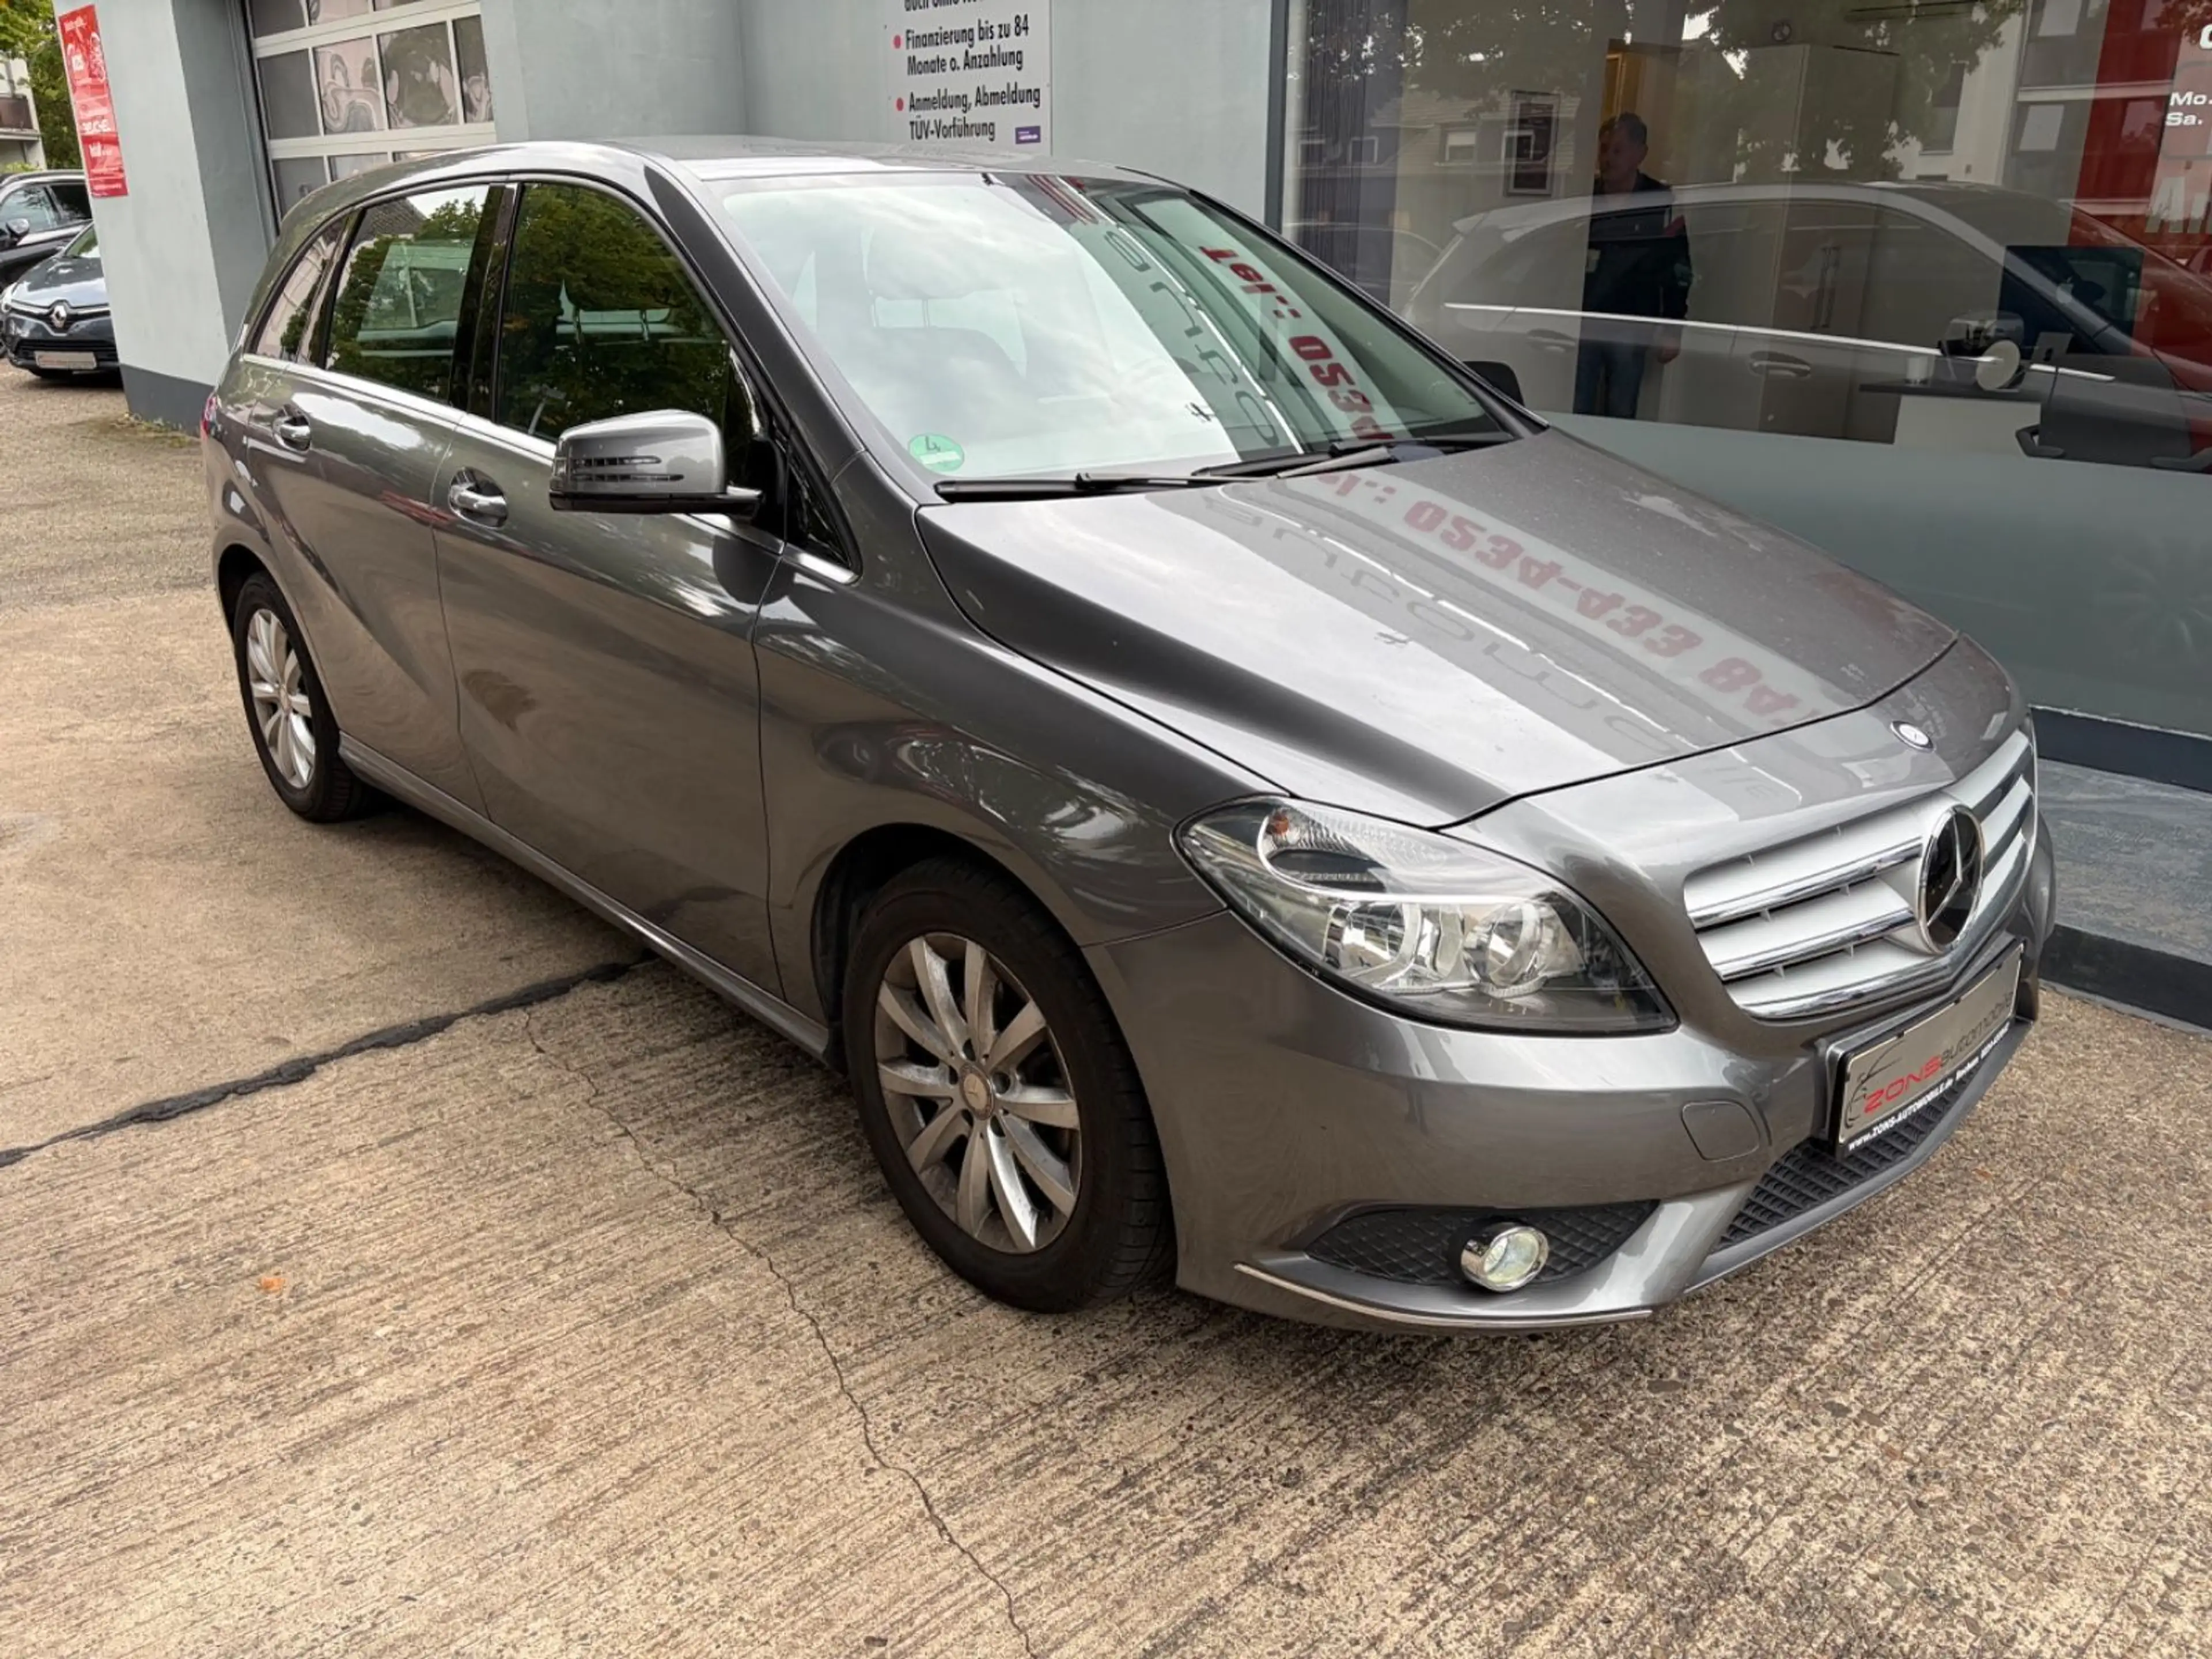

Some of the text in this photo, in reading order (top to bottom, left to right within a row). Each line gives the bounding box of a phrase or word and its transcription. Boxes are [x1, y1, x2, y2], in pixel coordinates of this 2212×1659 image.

[906, 14, 1029, 49] Finanzierung bis zu 84
[907, 44, 1023, 75] Monate o. Anzahlung
[909, 82, 1040, 113] Anmeldung, Abmeldung
[2169, 91, 2212, 107] Mo.
[909, 115, 995, 142] TÜV-Vorführung
[2166, 112, 2203, 126] Sa.
